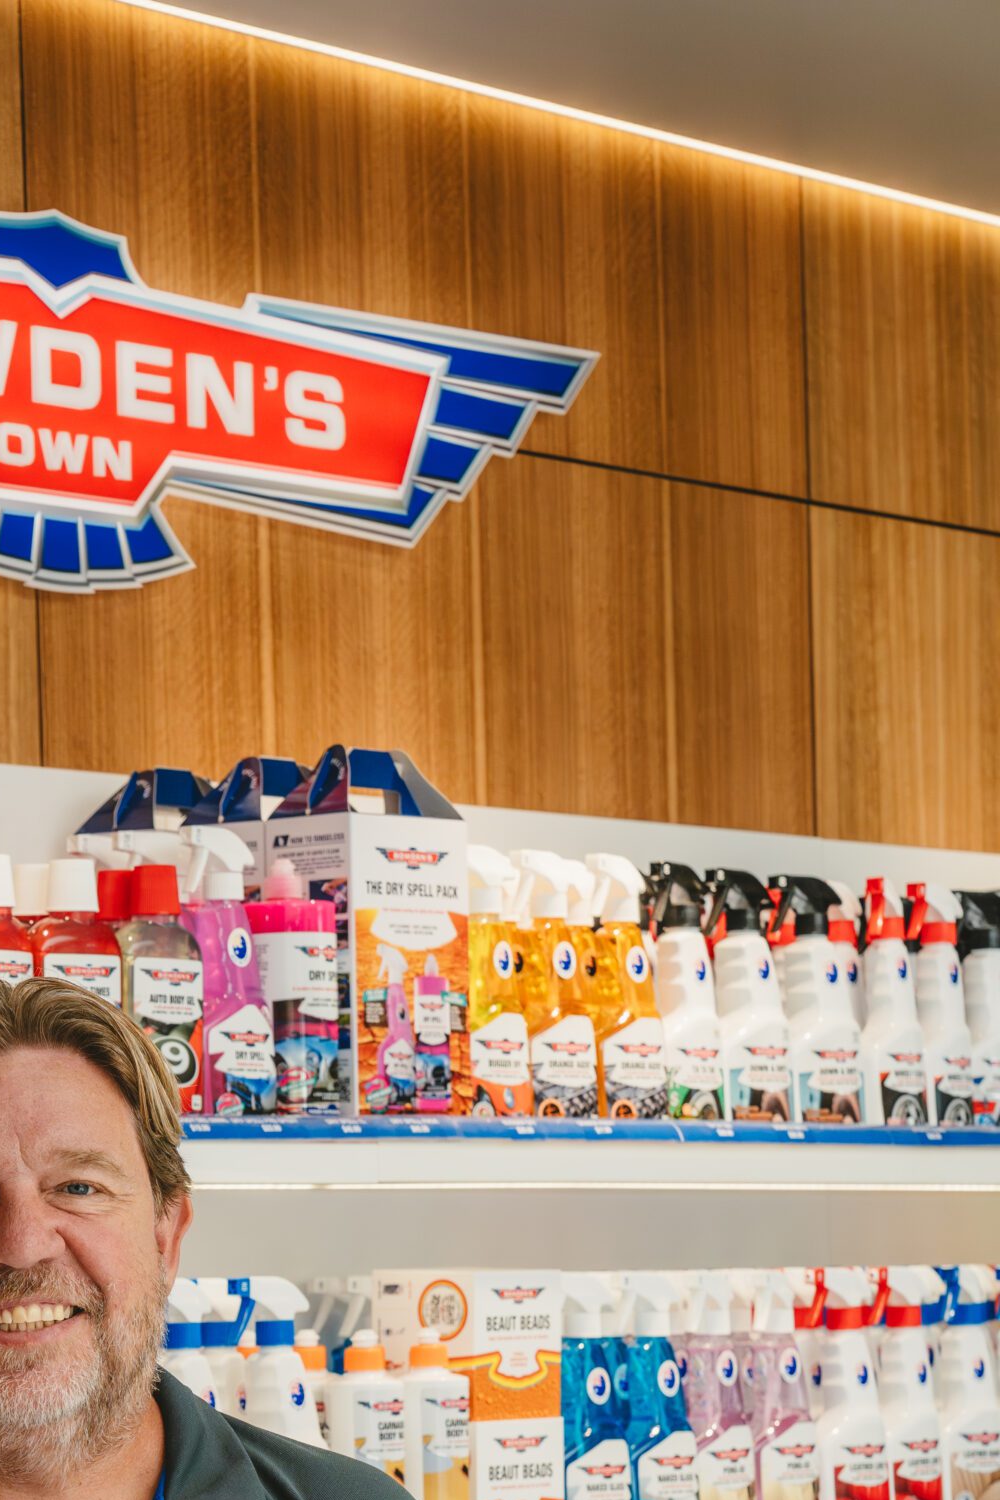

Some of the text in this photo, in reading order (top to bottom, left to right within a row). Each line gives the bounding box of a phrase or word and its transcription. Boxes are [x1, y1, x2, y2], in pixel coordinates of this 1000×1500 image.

[366, 880, 458, 898] THE DRY SPELL PACK
[308, 970, 325, 981] DRY
[486, 1314, 551, 1332] BEAUT BEADS
[489, 1463, 553, 1481] BEAUT BEADS
